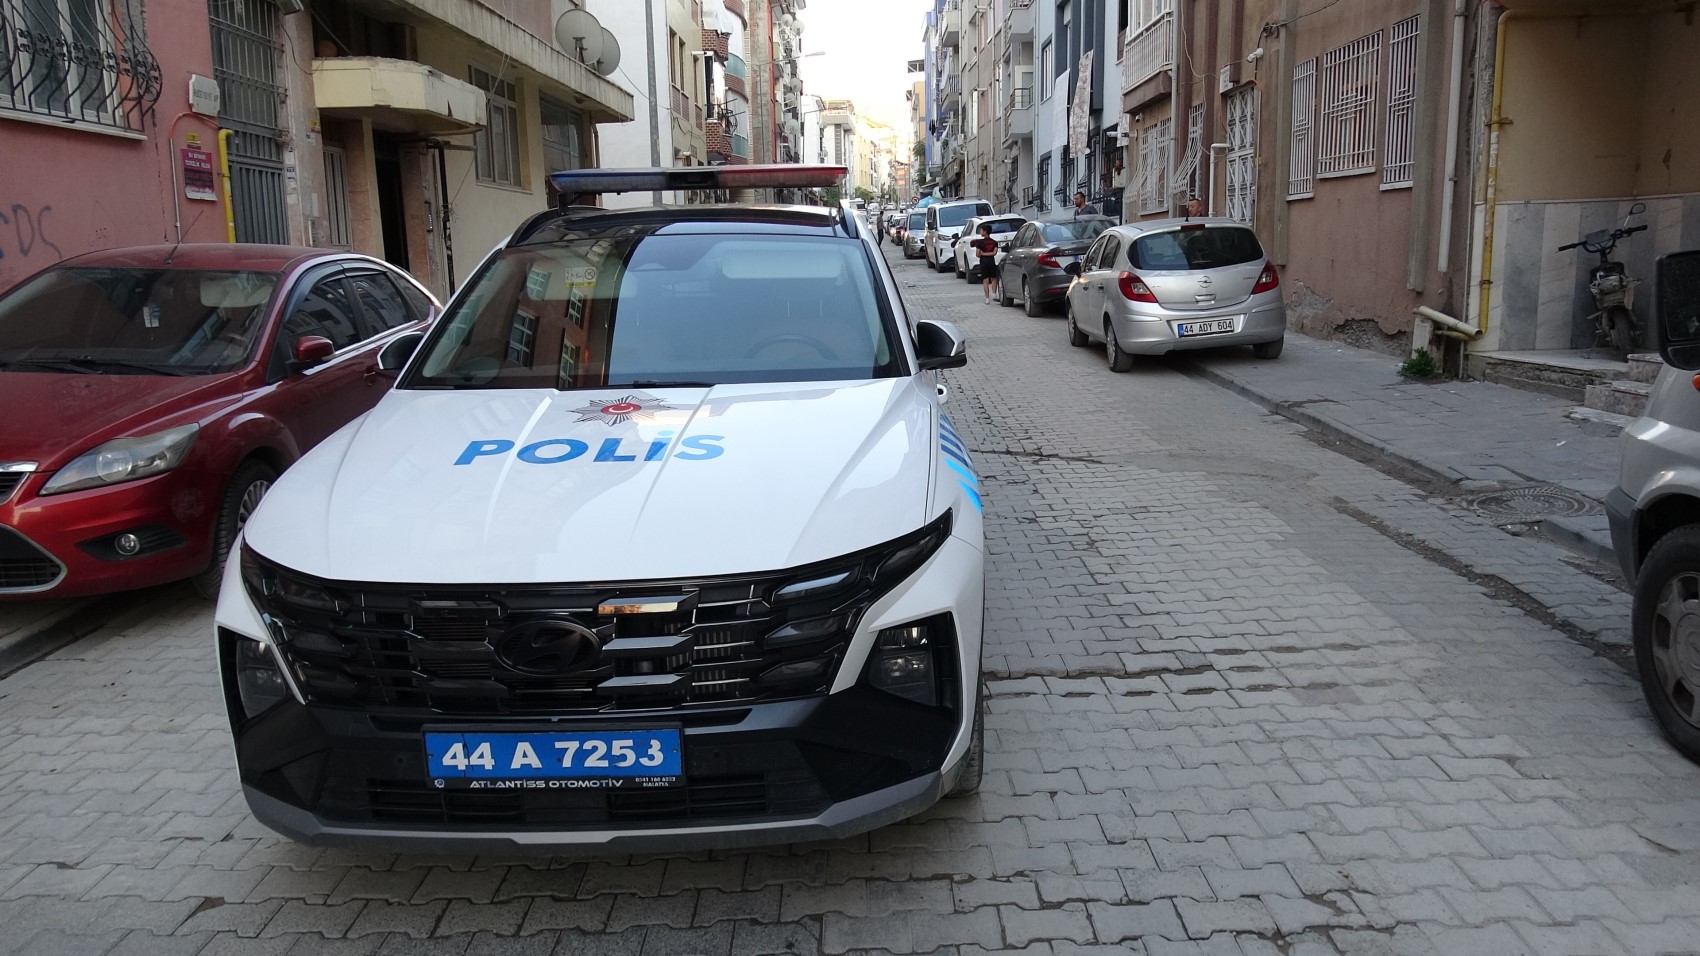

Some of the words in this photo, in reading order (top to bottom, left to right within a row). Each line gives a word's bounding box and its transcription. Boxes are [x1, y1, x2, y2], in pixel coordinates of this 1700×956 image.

[1184, 325, 1194, 334] 44
[1198, 323, 1213, 332] ADY
[1217, 320, 1232, 330] 604
[453, 430, 725, 466] POLİS
[442, 742, 495, 770] 44
[510, 742, 542, 769] A
[554, 739, 664, 768] 7253
[469, 779, 546, 788] ATLANTİSS
[548, 777, 624, 788] OTOMOTİV
